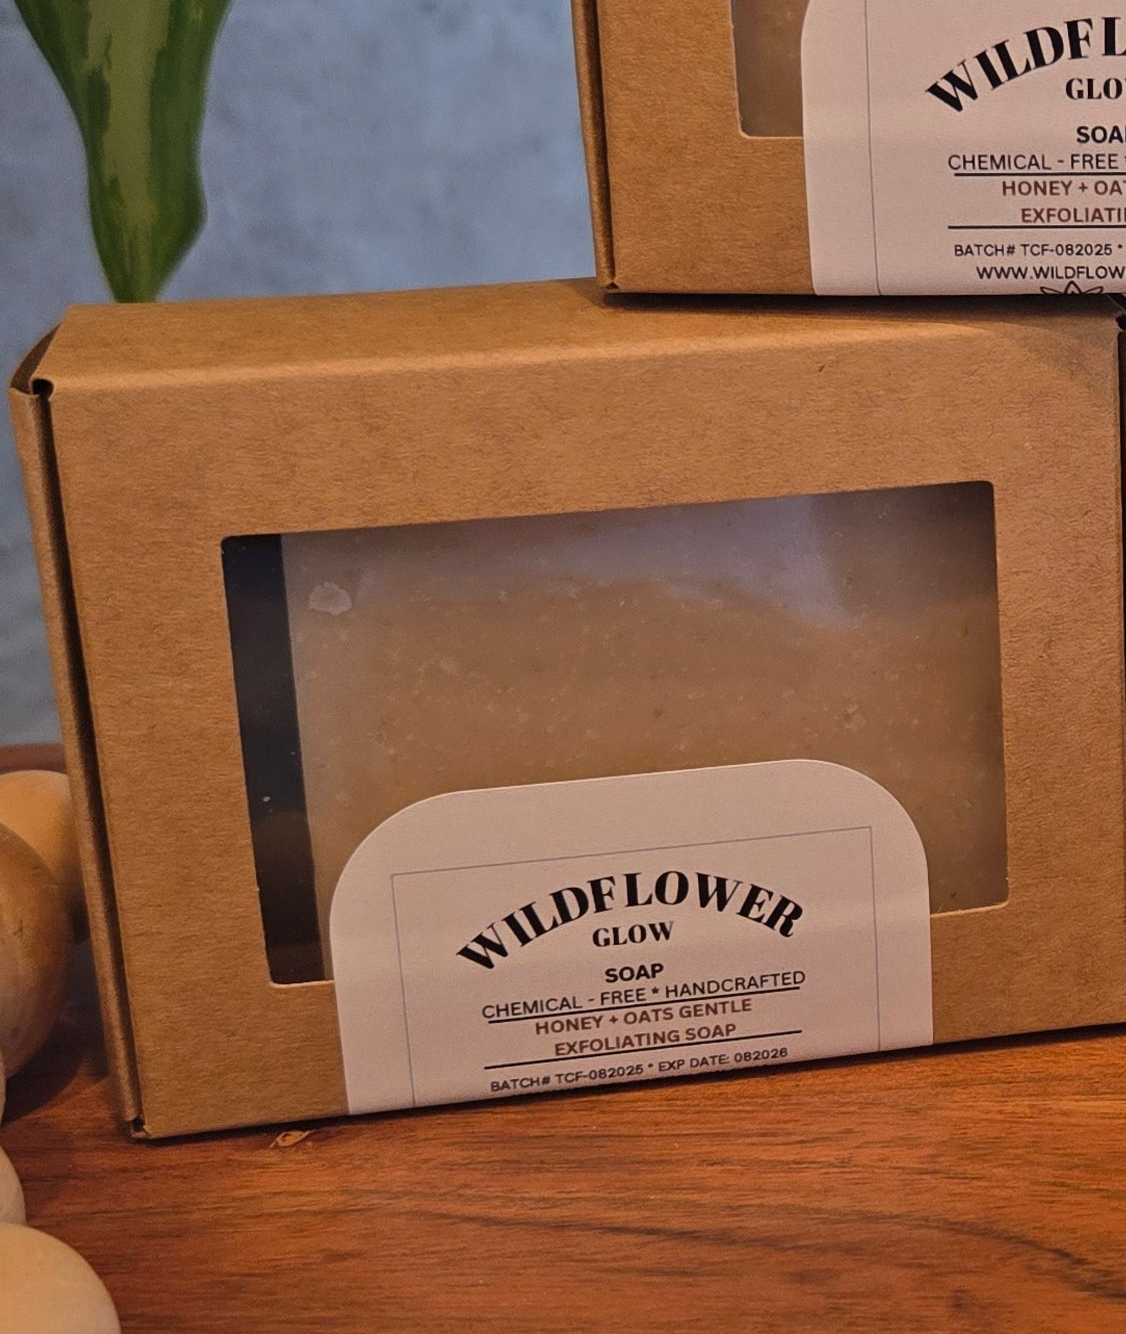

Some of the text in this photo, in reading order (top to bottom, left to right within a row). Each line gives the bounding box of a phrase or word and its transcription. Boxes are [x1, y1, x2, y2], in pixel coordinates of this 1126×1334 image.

[948, 154, 1051, 171] CHEMICAL
[1070, 153, 1119, 170] FREE
[1002, 180, 1073, 196] HONEY
[1078, 183, 1088, 194] +
[954, 244, 1016, 257] BATCH#
[1021, 244, 1113, 257] TCF-082025
[456, 870, 804, 970] WILDFLOWER
[592, 920, 675, 948] GLOW
[605, 963, 664, 983] SOAP
[482, 995, 583, 1019] CHEMICAL
[600, 988, 646, 1006] FREE
[665, 970, 806, 999] HANDCRAFTED
[535, 999, 752, 1035] HONEY + OATS GENTLE
[555, 1024, 737, 1057] EXFOLIATING SOAP
[491, 1075, 551, 1092] BATCH#
[555, 1064, 644, 1085] TCF-082025
[658, 1059, 686, 1072] EXP
[690, 1054, 730, 1069] DATE:
[734, 1047, 788, 1063] 082026
